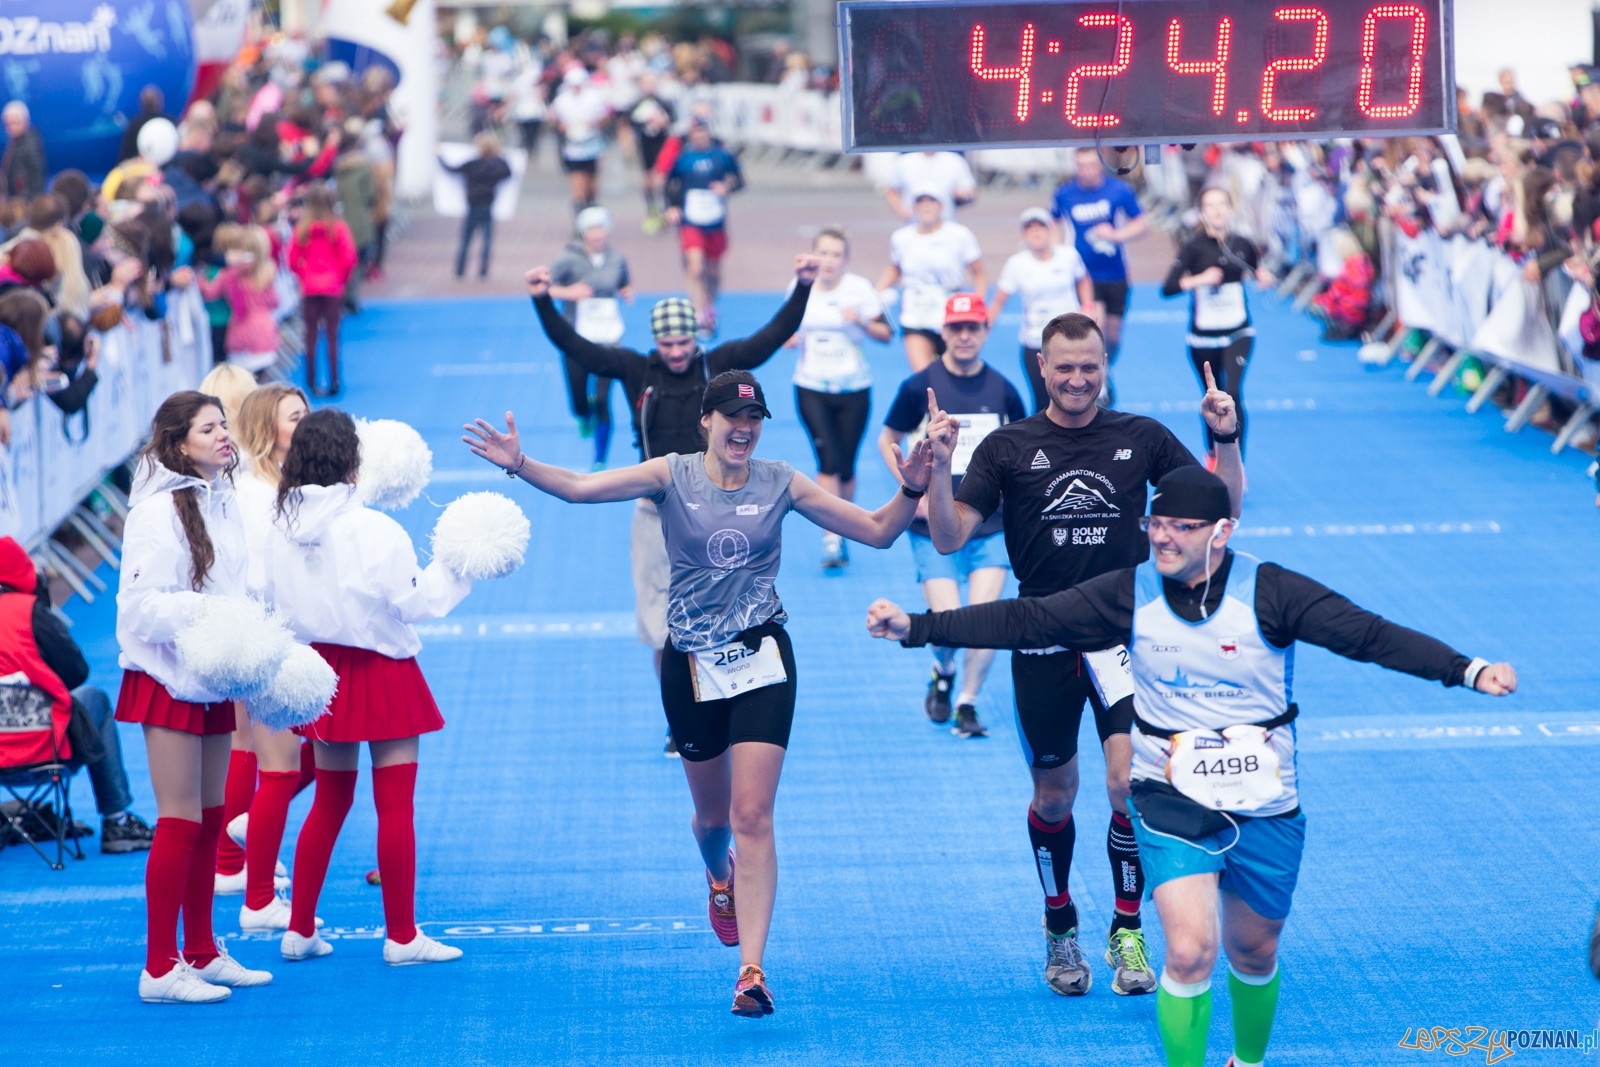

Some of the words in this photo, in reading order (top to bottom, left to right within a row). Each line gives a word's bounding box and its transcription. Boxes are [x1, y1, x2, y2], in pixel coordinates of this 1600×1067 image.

[1044, 468, 1095, 497] ULTRAMARATON
[1094, 472, 1117, 495] GÓRSKI
[1072, 526, 1108, 536] DOLNY
[1072, 534, 1106, 546] ŚLĄSK
[1204, 689, 1244, 698] BIEGA
[1193, 754, 1259, 777] 4498
[1121, 860, 1130, 892] COMPRES
